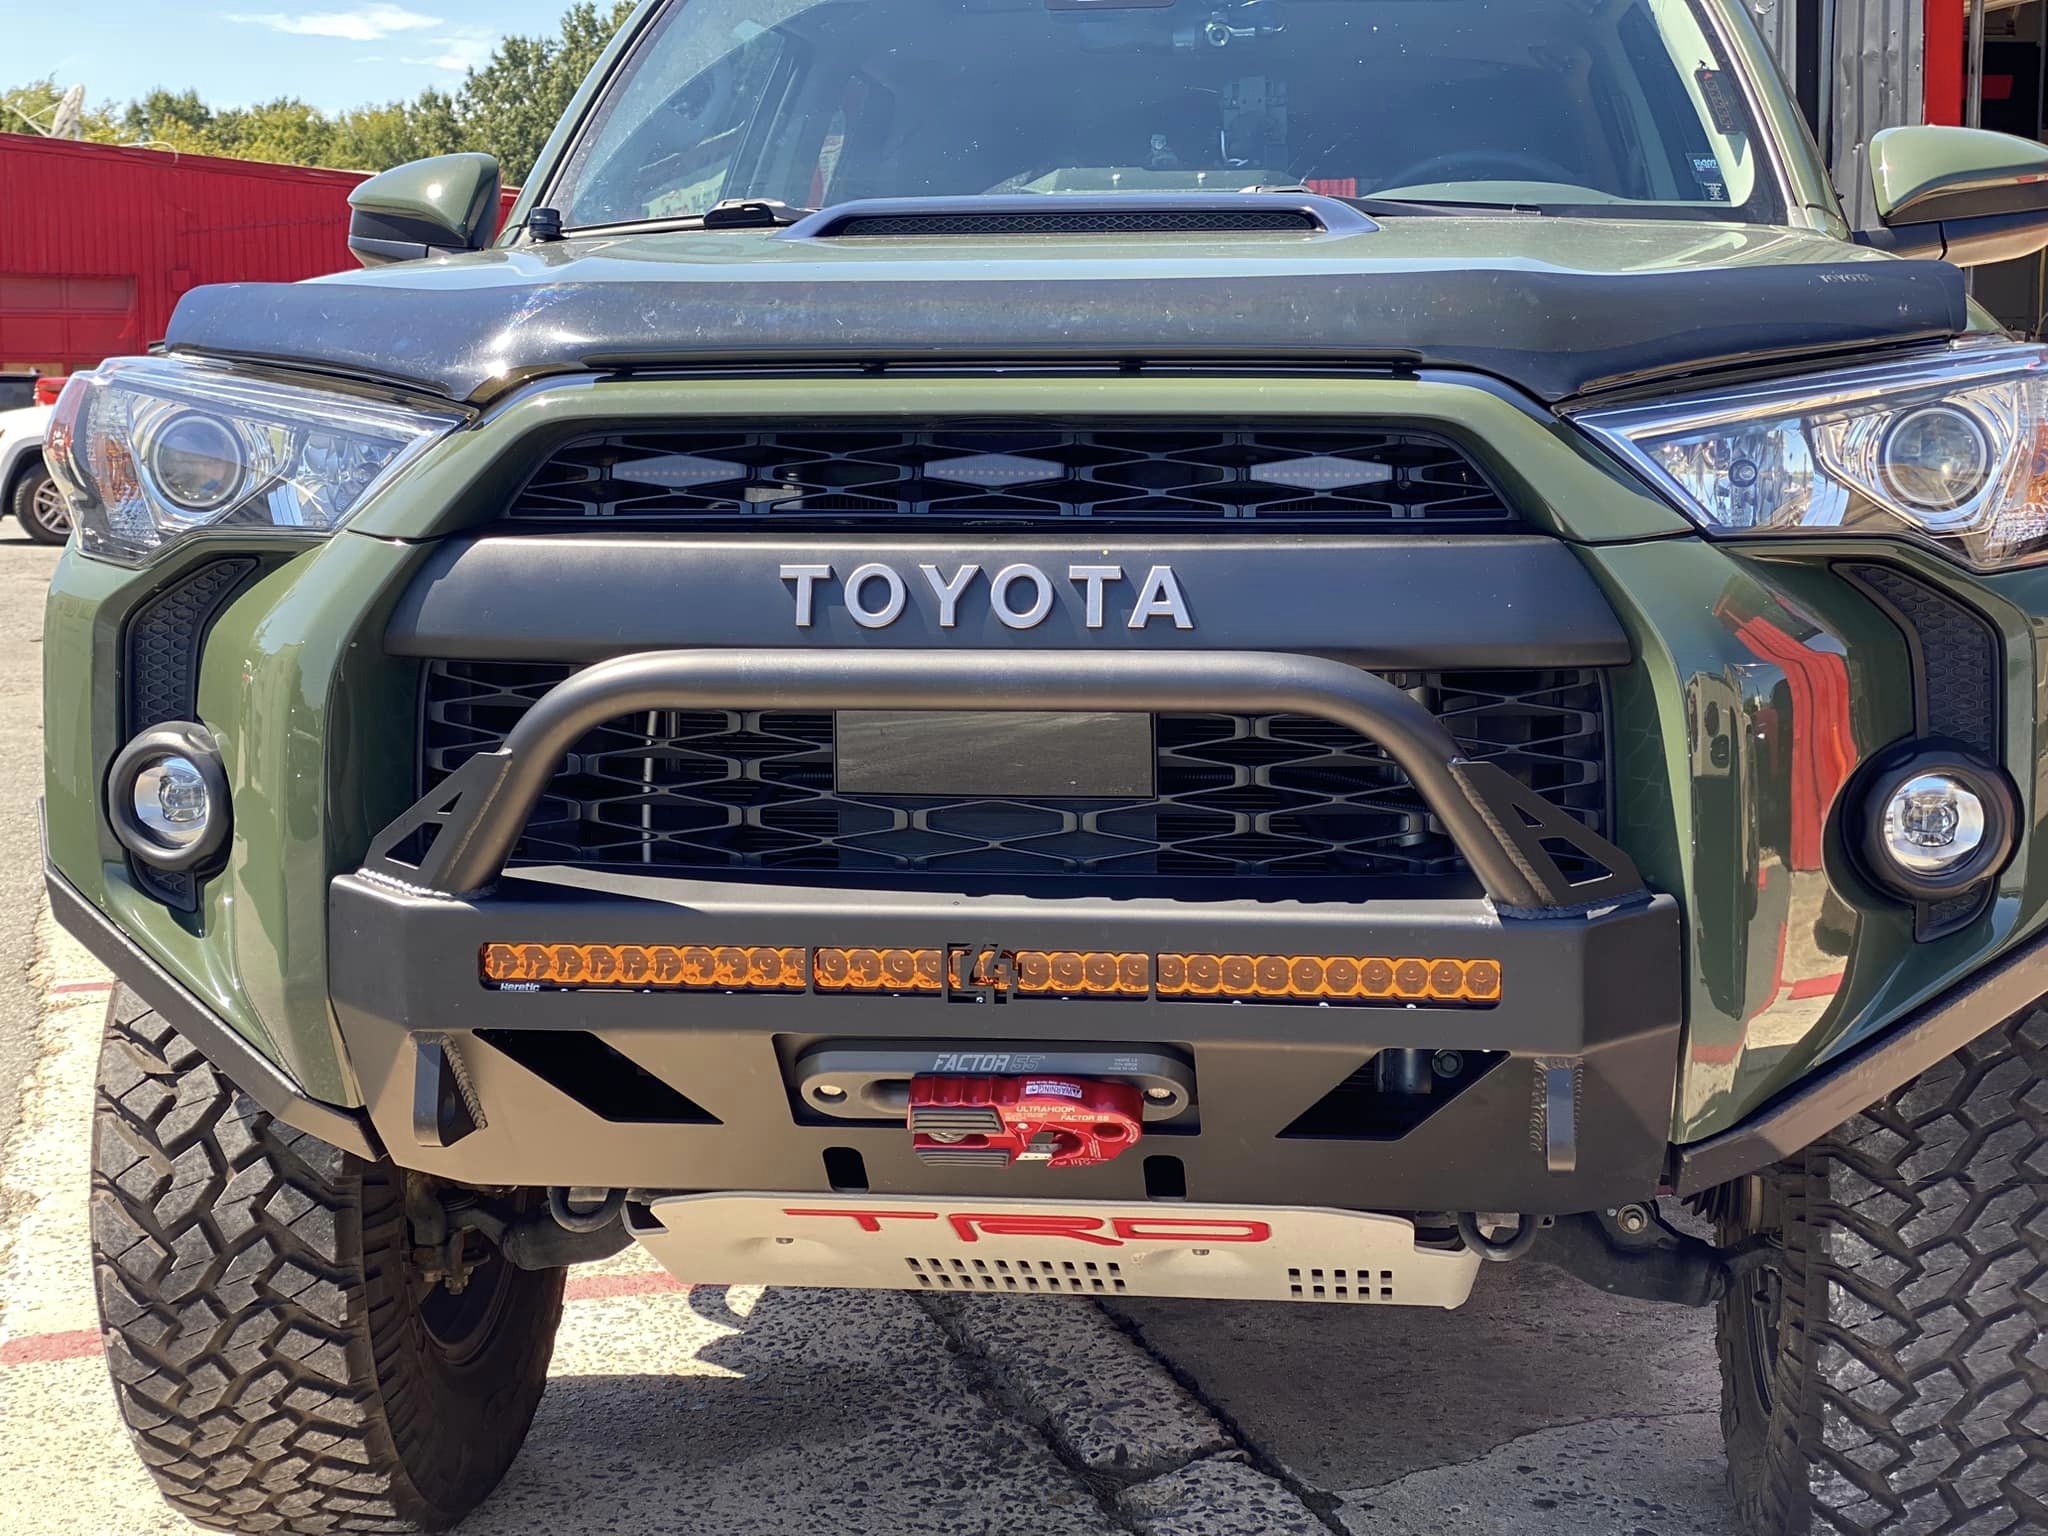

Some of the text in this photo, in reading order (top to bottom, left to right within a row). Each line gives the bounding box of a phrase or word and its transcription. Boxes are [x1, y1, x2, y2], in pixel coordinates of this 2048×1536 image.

[779, 563, 1194, 629] TOYOTA
[932, 1054, 1010, 1072] FACTOR
[1038, 1084, 1073, 1097] WARNING
[1016, 1105, 1076, 1114] ULTRAHOOK
[783, 1208, 1272, 1247] TRD
